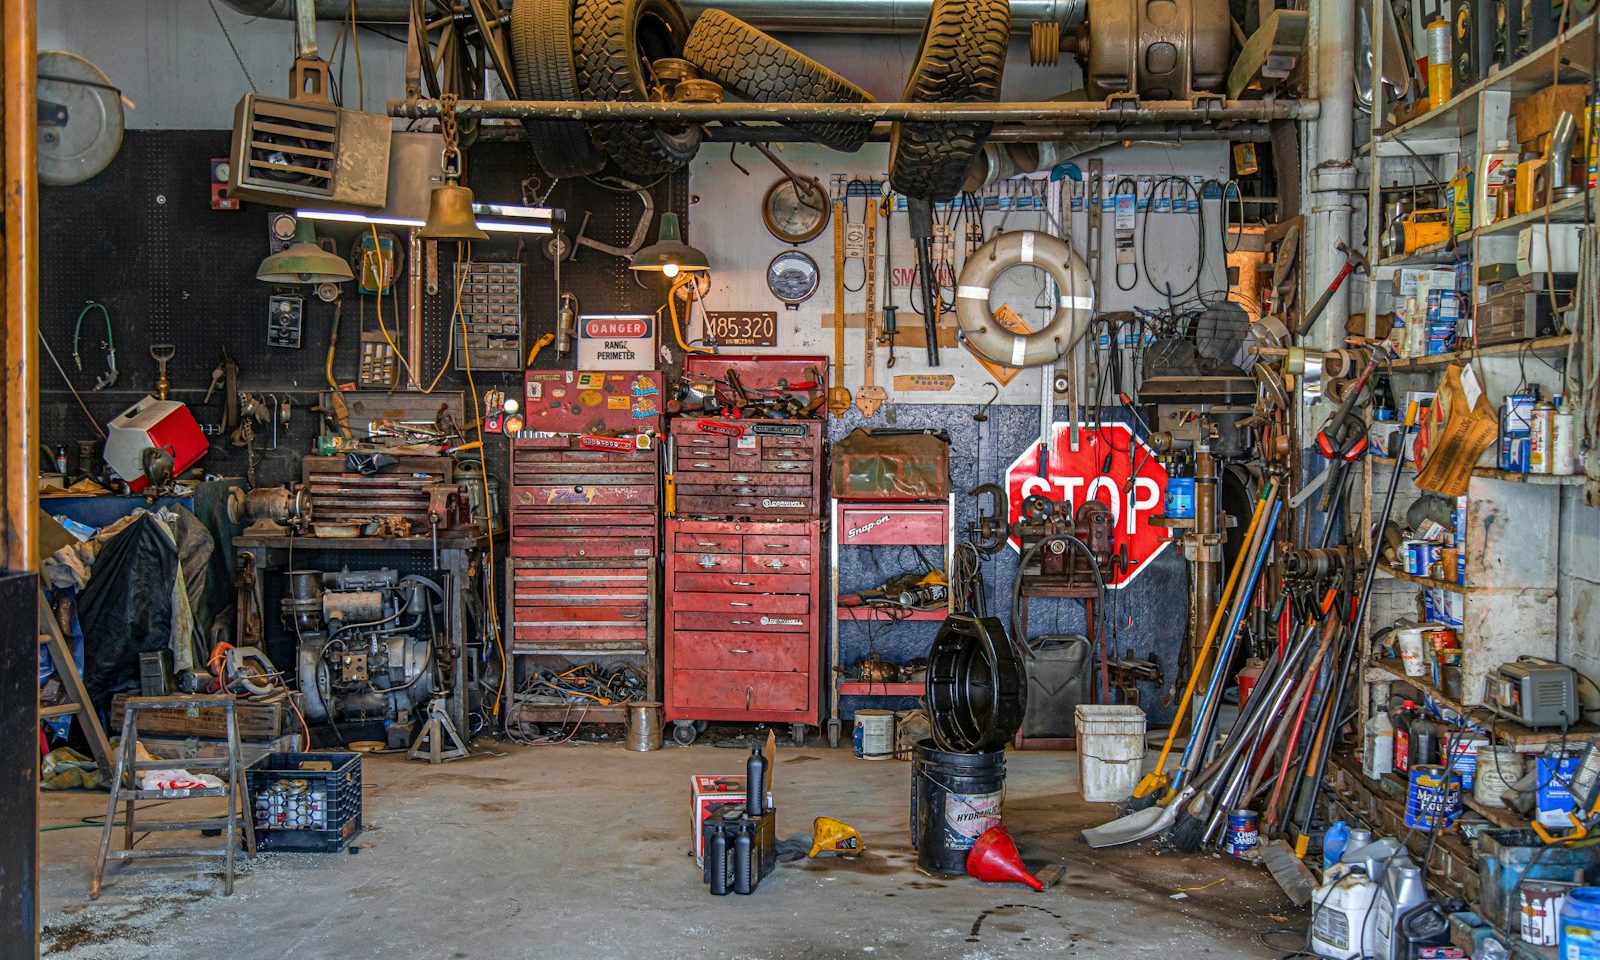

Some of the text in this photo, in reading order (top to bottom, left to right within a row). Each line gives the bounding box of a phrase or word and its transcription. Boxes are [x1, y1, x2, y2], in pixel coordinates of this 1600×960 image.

[591, 323, 642, 334] DANGER
[604, 340, 629, 350] RANGE
[596, 350, 636, 361] PERIMETER
[1021, 476, 1160, 535] STOP
[847, 515, 890, 538] Snap-on
